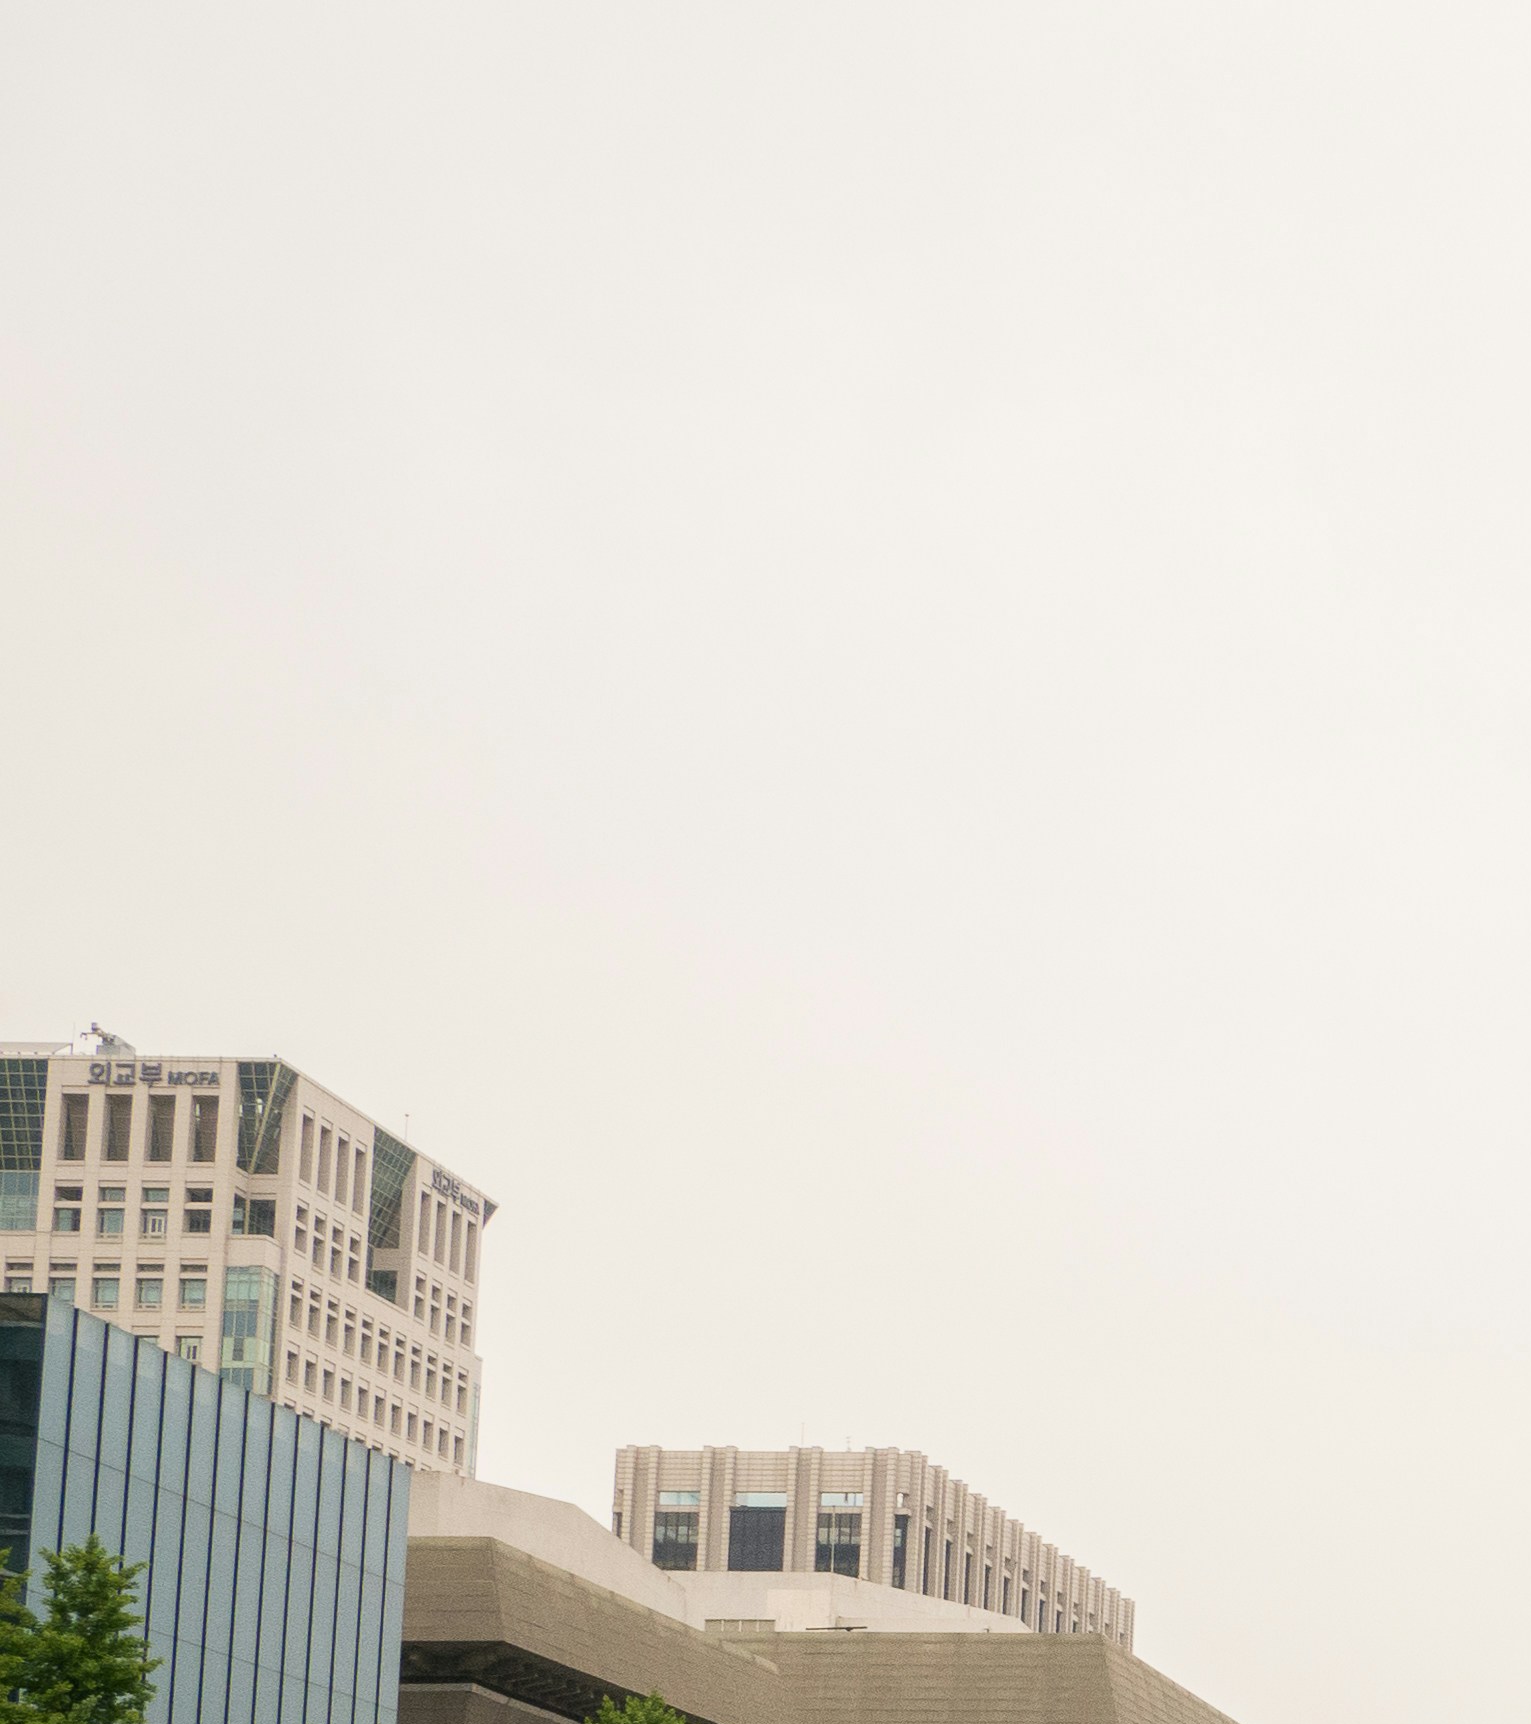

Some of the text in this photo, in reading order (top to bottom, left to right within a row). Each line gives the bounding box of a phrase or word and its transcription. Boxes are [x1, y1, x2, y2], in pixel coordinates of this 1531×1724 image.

[88, 1061, 162, 1087] 외교부
[168, 1070, 219, 1085] MOFA
[432, 1169, 460, 1202] 외교부
